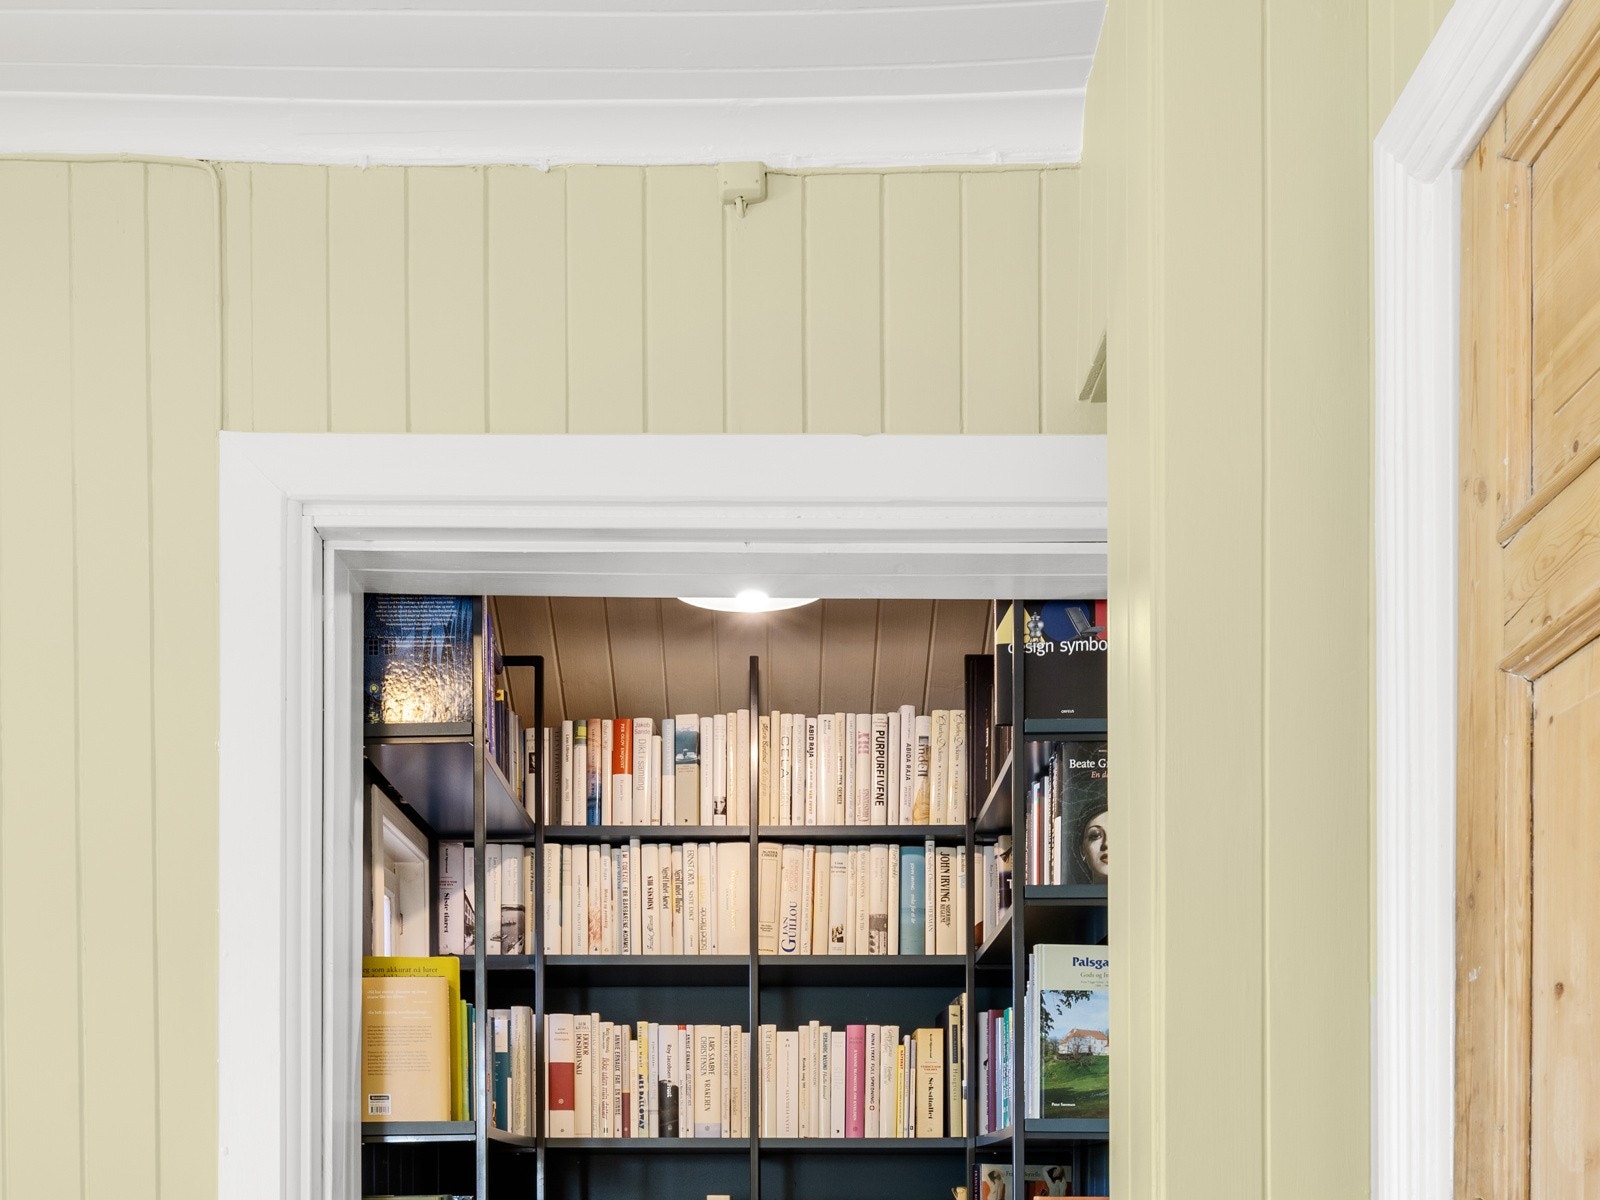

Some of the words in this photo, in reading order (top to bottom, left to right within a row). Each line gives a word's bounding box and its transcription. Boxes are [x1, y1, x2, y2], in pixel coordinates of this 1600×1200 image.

[635, 738, 647, 754] Dikt
[635, 760, 647, 792] samling
[1069, 758, 1095, 769] Beate
[940, 851, 950, 874] JOHN
[940, 875, 950, 902] IRVING
[780, 902, 798, 953] GUILLOU
